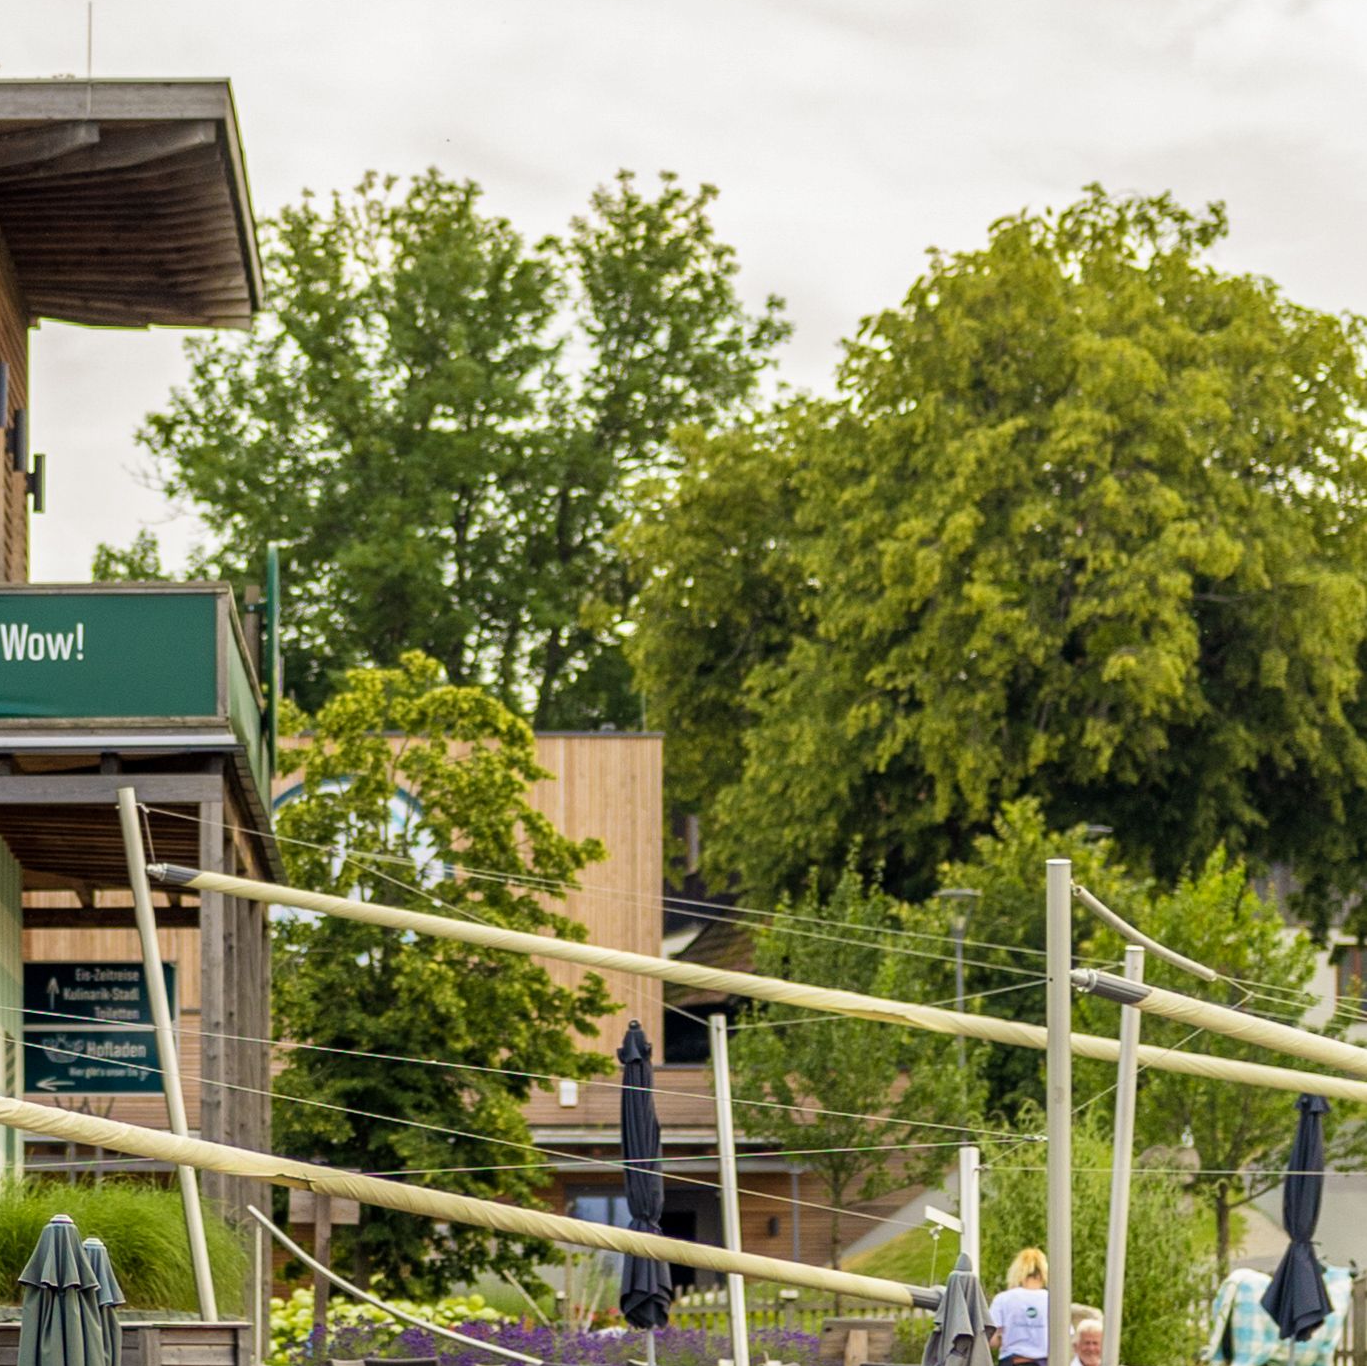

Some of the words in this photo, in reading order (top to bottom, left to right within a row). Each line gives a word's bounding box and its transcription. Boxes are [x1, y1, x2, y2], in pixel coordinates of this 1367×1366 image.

[0, 623, 85, 661] Wow!
[75, 968, 140, 982] Eis-Zeitreise
[62, 987, 140, 1001] Kulinarik-Stadl
[94, 1006, 140, 1020] Toiletten
[86, 1040, 147, 1058] Hofladen
